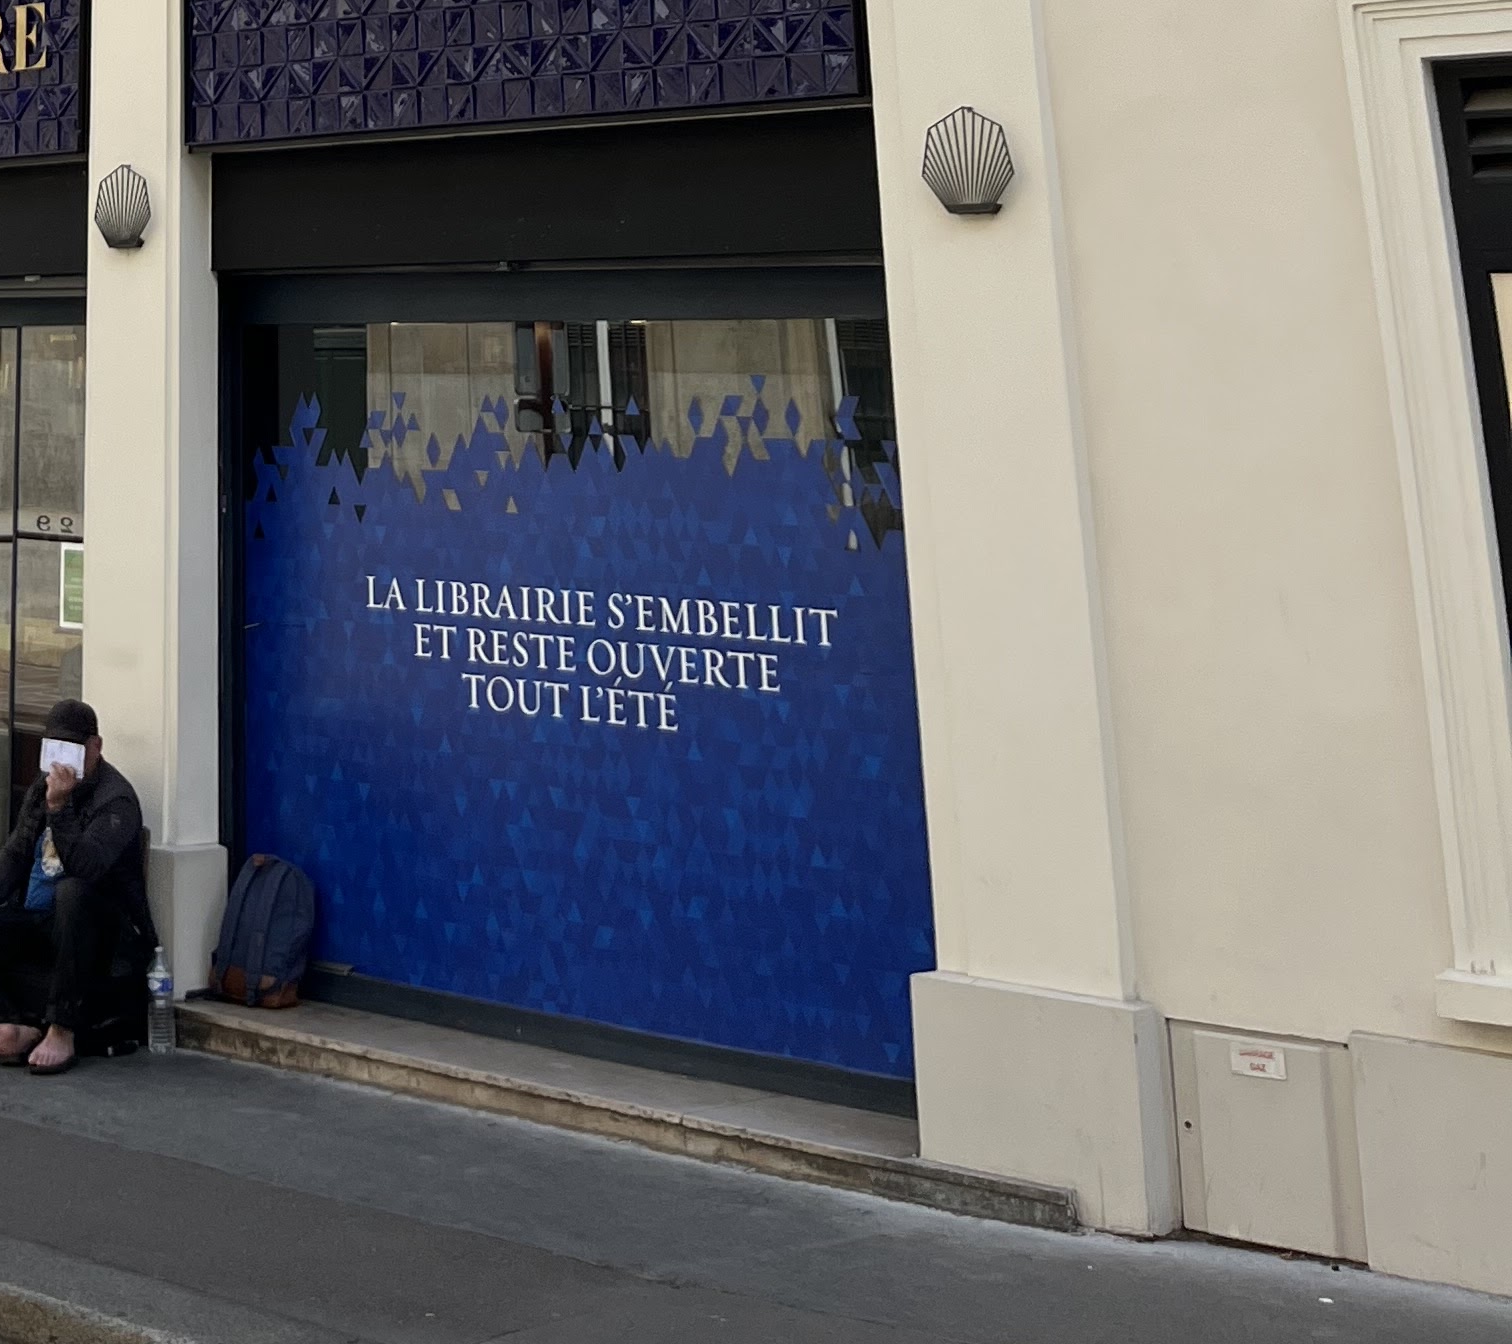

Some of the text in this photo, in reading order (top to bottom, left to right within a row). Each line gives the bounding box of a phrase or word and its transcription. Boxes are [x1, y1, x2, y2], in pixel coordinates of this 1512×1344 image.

[365, 575, 839, 648] LA LIBRAIRIE S'EMBELLIT
[413, 623, 781, 693] ET RESTE OUVERTE
[461, 672, 679, 731] TOUT L'ÉTÉ
